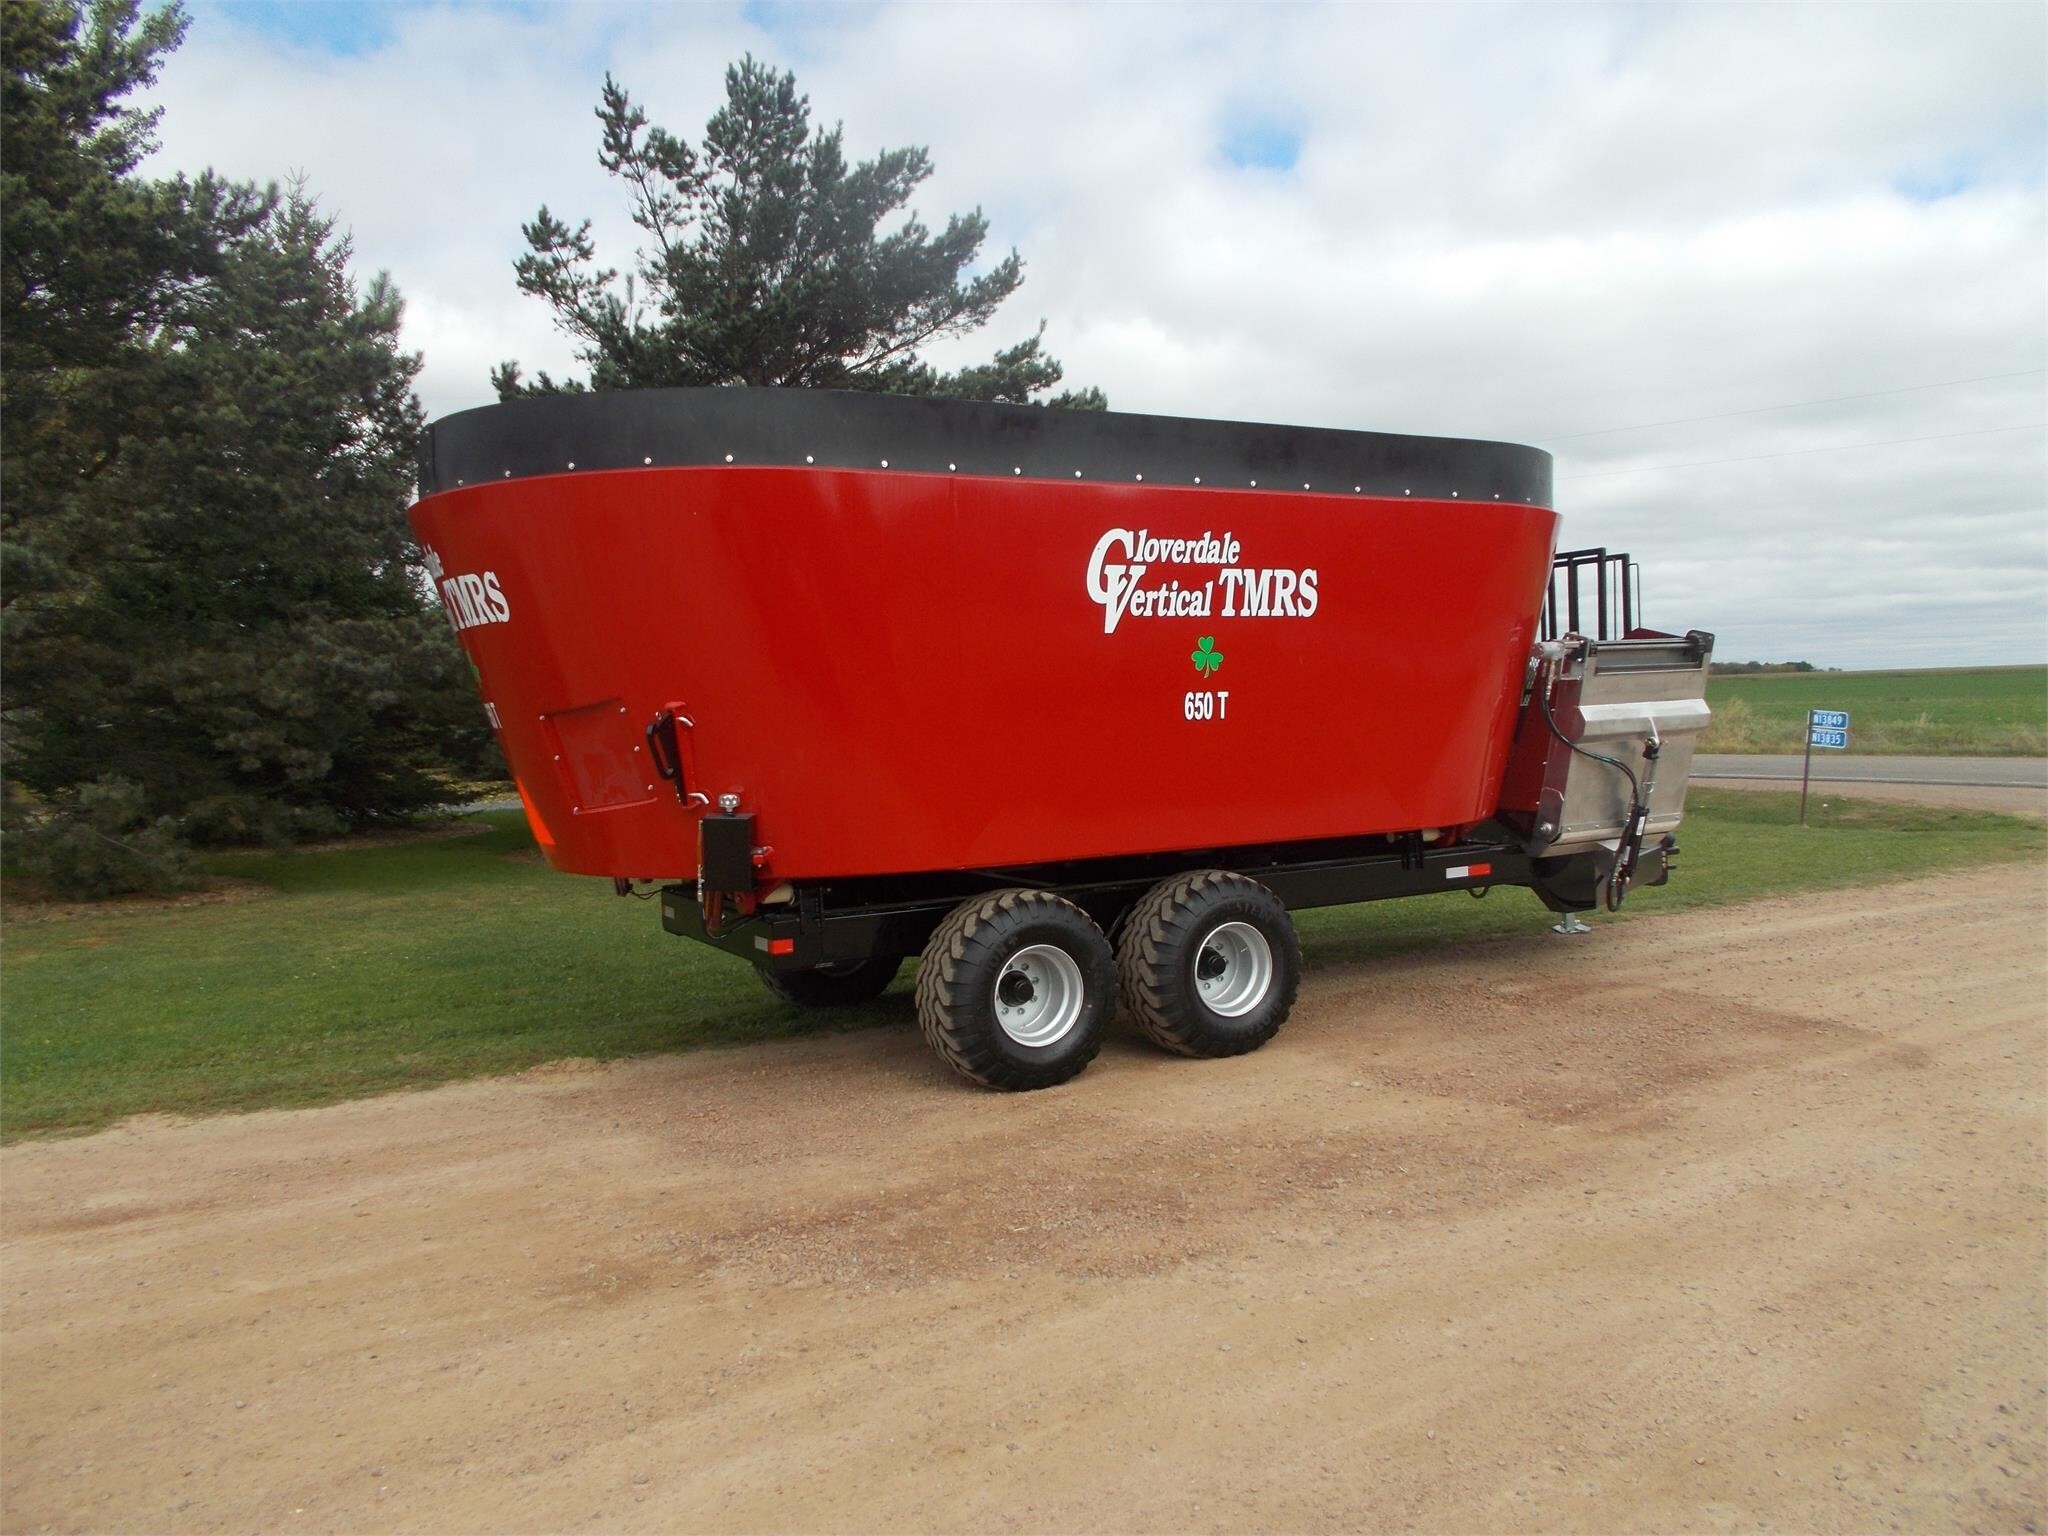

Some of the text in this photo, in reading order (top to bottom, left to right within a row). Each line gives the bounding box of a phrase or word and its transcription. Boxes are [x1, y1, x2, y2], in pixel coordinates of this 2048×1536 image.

[1086, 528, 1241, 604] Cloverdale
[442, 571, 510, 630] TMRS
[1103, 565, 1318, 633] Vertical TMRS
[1184, 691, 1229, 720] 650 T
